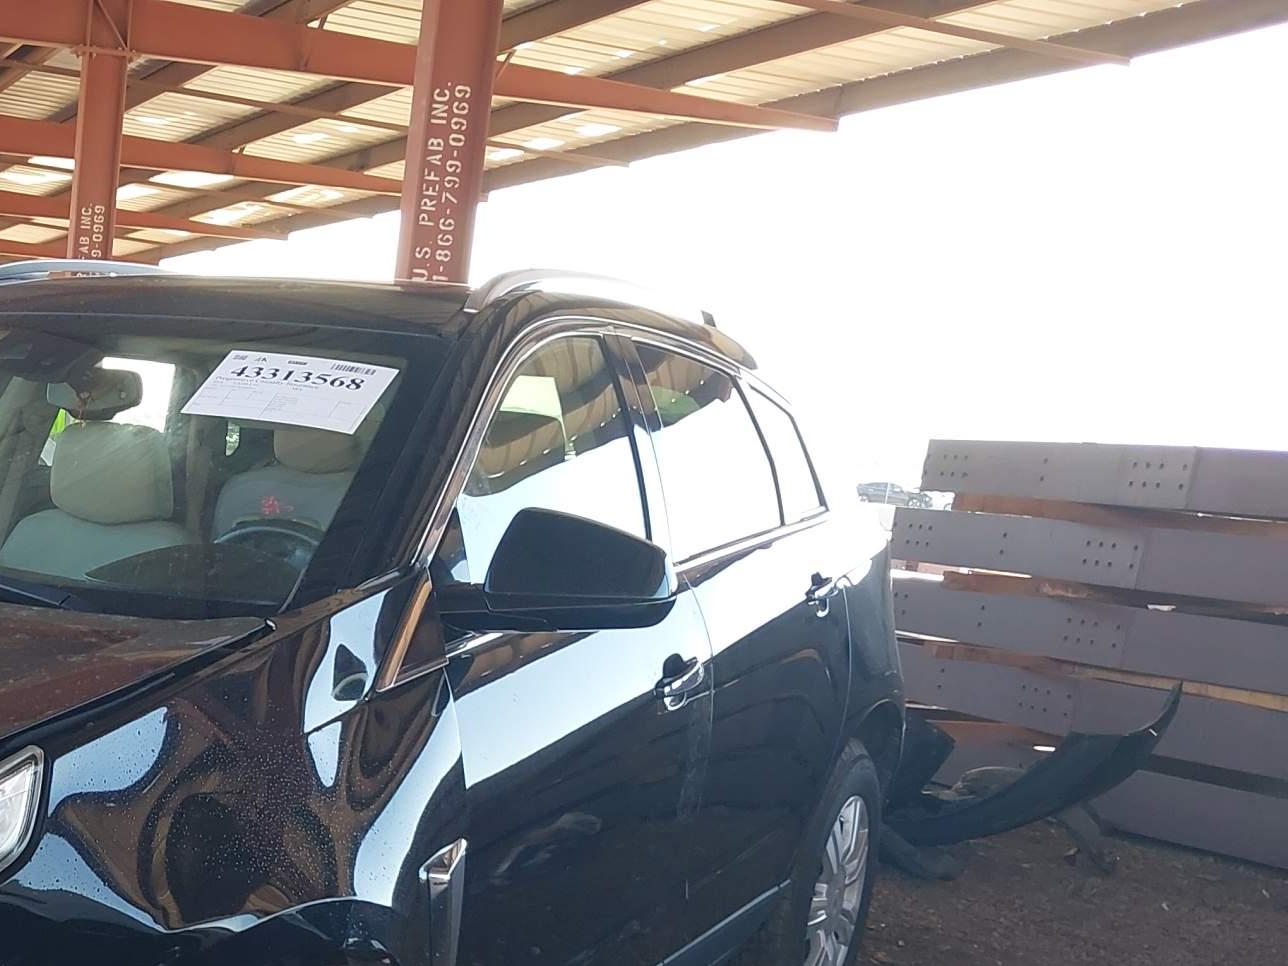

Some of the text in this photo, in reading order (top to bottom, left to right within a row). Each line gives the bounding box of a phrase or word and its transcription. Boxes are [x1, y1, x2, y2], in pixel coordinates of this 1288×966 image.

[430, 81, 452, 124] INC.
[419, 137, 444, 226] PREFAB
[230, 365, 365, 391] 43313568
